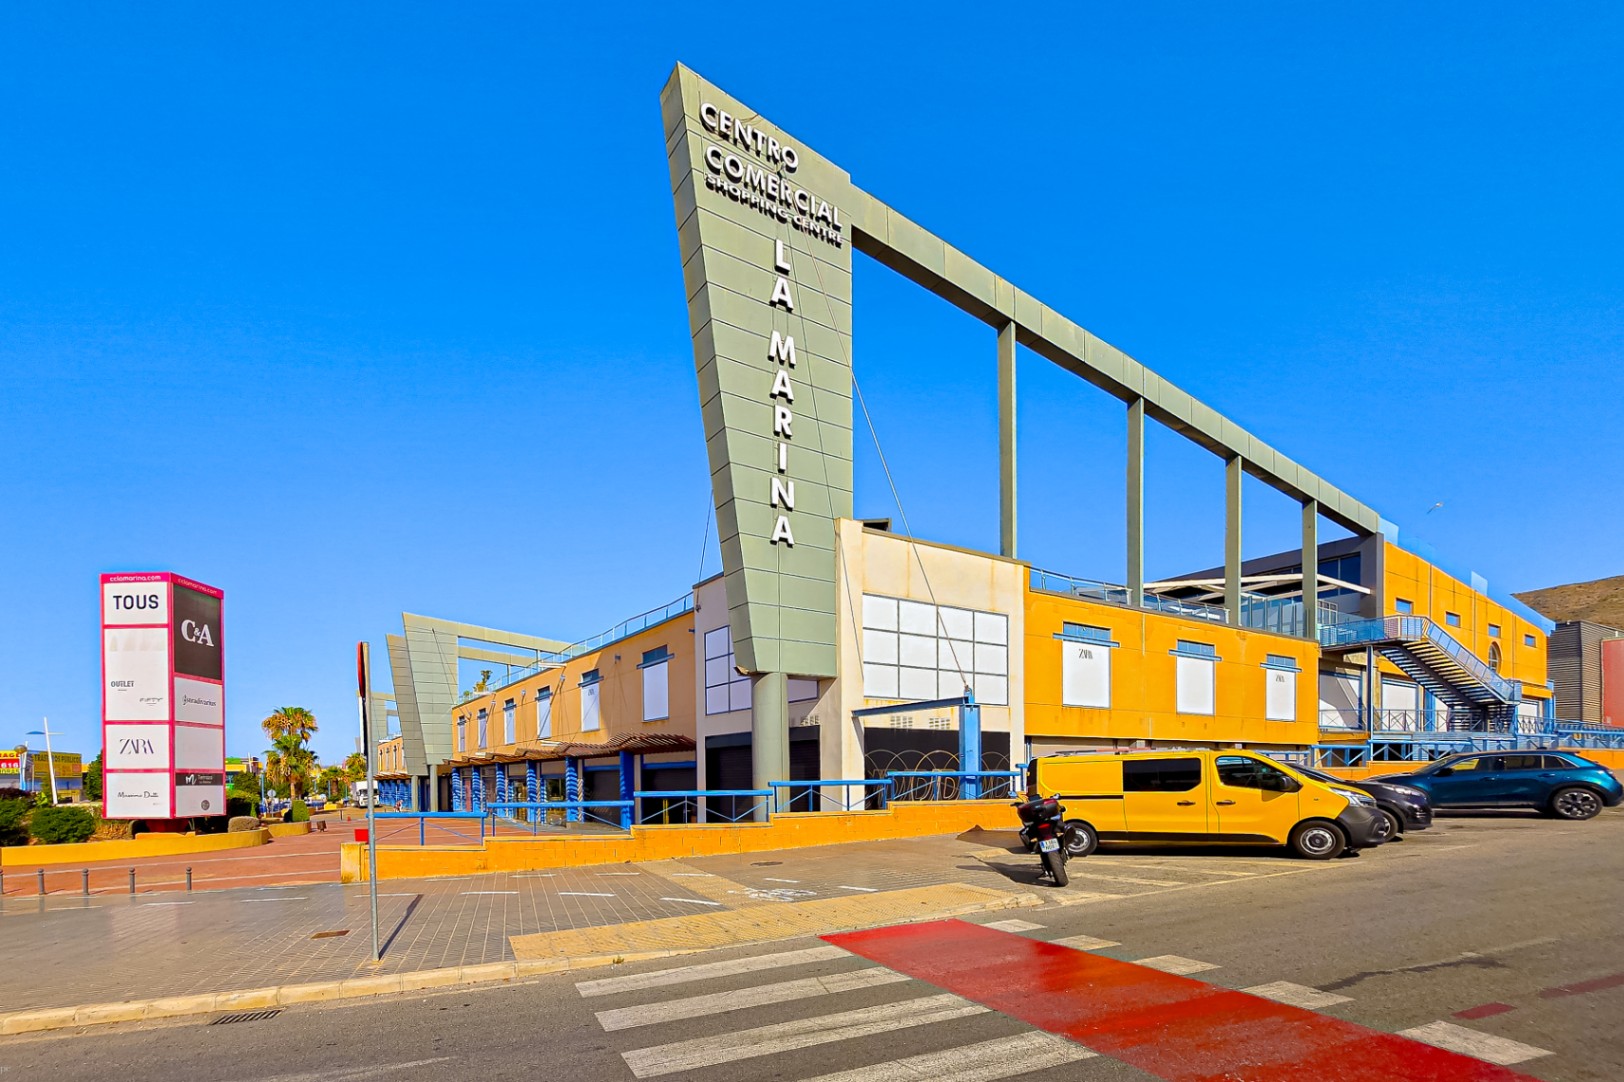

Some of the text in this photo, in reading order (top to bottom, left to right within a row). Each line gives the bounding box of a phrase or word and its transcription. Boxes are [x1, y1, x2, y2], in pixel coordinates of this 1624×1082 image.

[700, 102, 799, 170] CENTRO
[706, 144, 843, 228] COMERCIAL
[706, 174, 843, 245] SHOPPING CENTRE
[768, 238, 797, 546] LA MARINA
[113, 594, 159, 610] TOUS
[181, 618, 215, 647] C&A
[110, 680, 134, 688] OUTLET
[119, 738, 155, 755] ZARA
